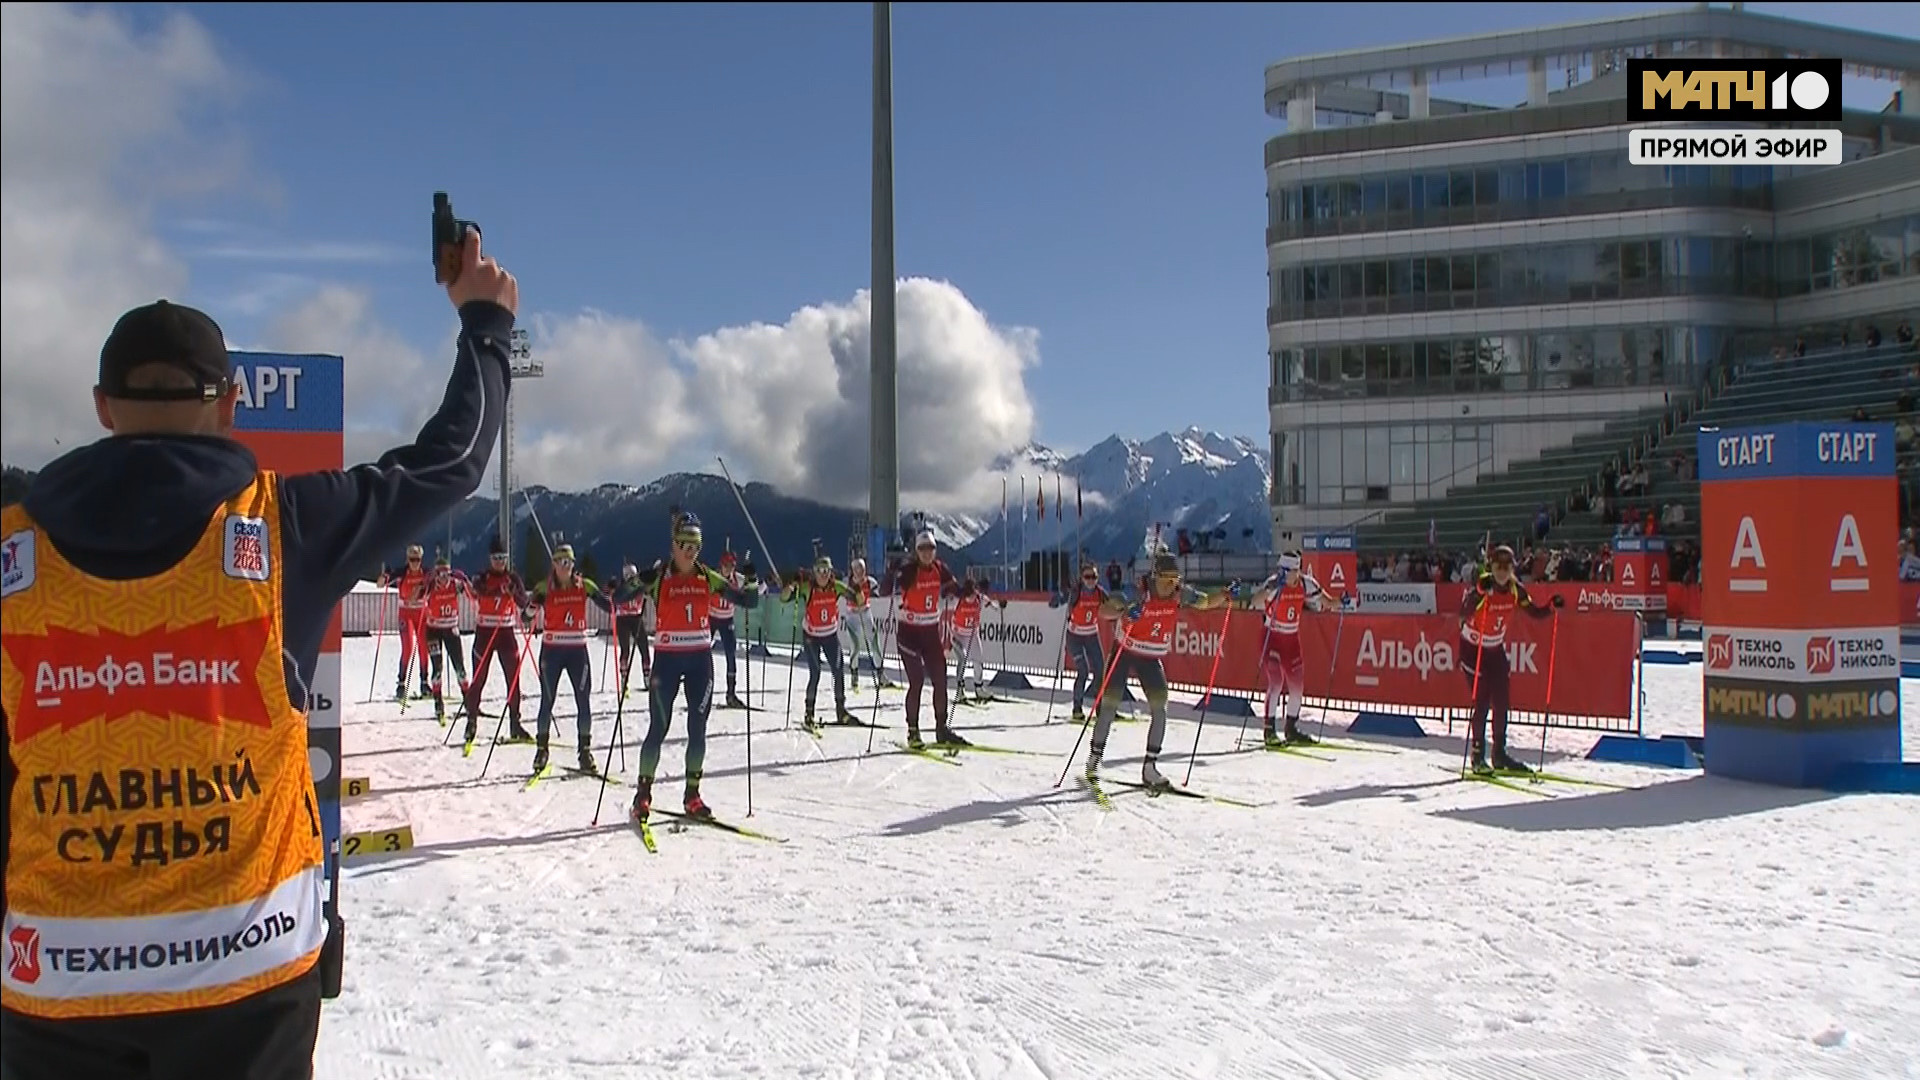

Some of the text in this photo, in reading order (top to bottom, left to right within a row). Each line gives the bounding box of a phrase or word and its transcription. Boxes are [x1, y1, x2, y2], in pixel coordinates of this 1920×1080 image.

[235, 366, 301, 409] АРТ
[1718, 434, 1774, 466] СТАРТ
[1818, 432, 1876, 462] СТАРТ
[494, 597, 501, 610] 7
[1363, 592, 1421, 603] ТЕХНОНИКОЛЬ
[440, 605, 451, 616] 10
[685, 603, 693, 623] 1
[821, 609, 828, 622] 8
[1287, 607, 1295, 620] 6
[564, 611, 574, 628] 4
[1150, 622, 1162, 637] 2
[1175, 621, 1224, 658] Банк
[1736, 639, 1782, 653] ТЕХНО
[1838, 639, 1884, 652] ТЕХНО
[1356, 630, 1454, 681] Альфа
[1739, 655, 1795, 670] НИКОЛЬ
[1841, 654, 1896, 668] НИКОЛЬ
[35, 653, 240, 694] Альфа Банк
[32, 748, 262, 815] ГЛАВНЫЙ
[348, 780, 361, 796] 6
[57, 816, 231, 867] СУДЬЯ
[345, 832, 401, 856] 2 3
[45, 911, 297, 974] ТЕХНОНИКОЛЬ
